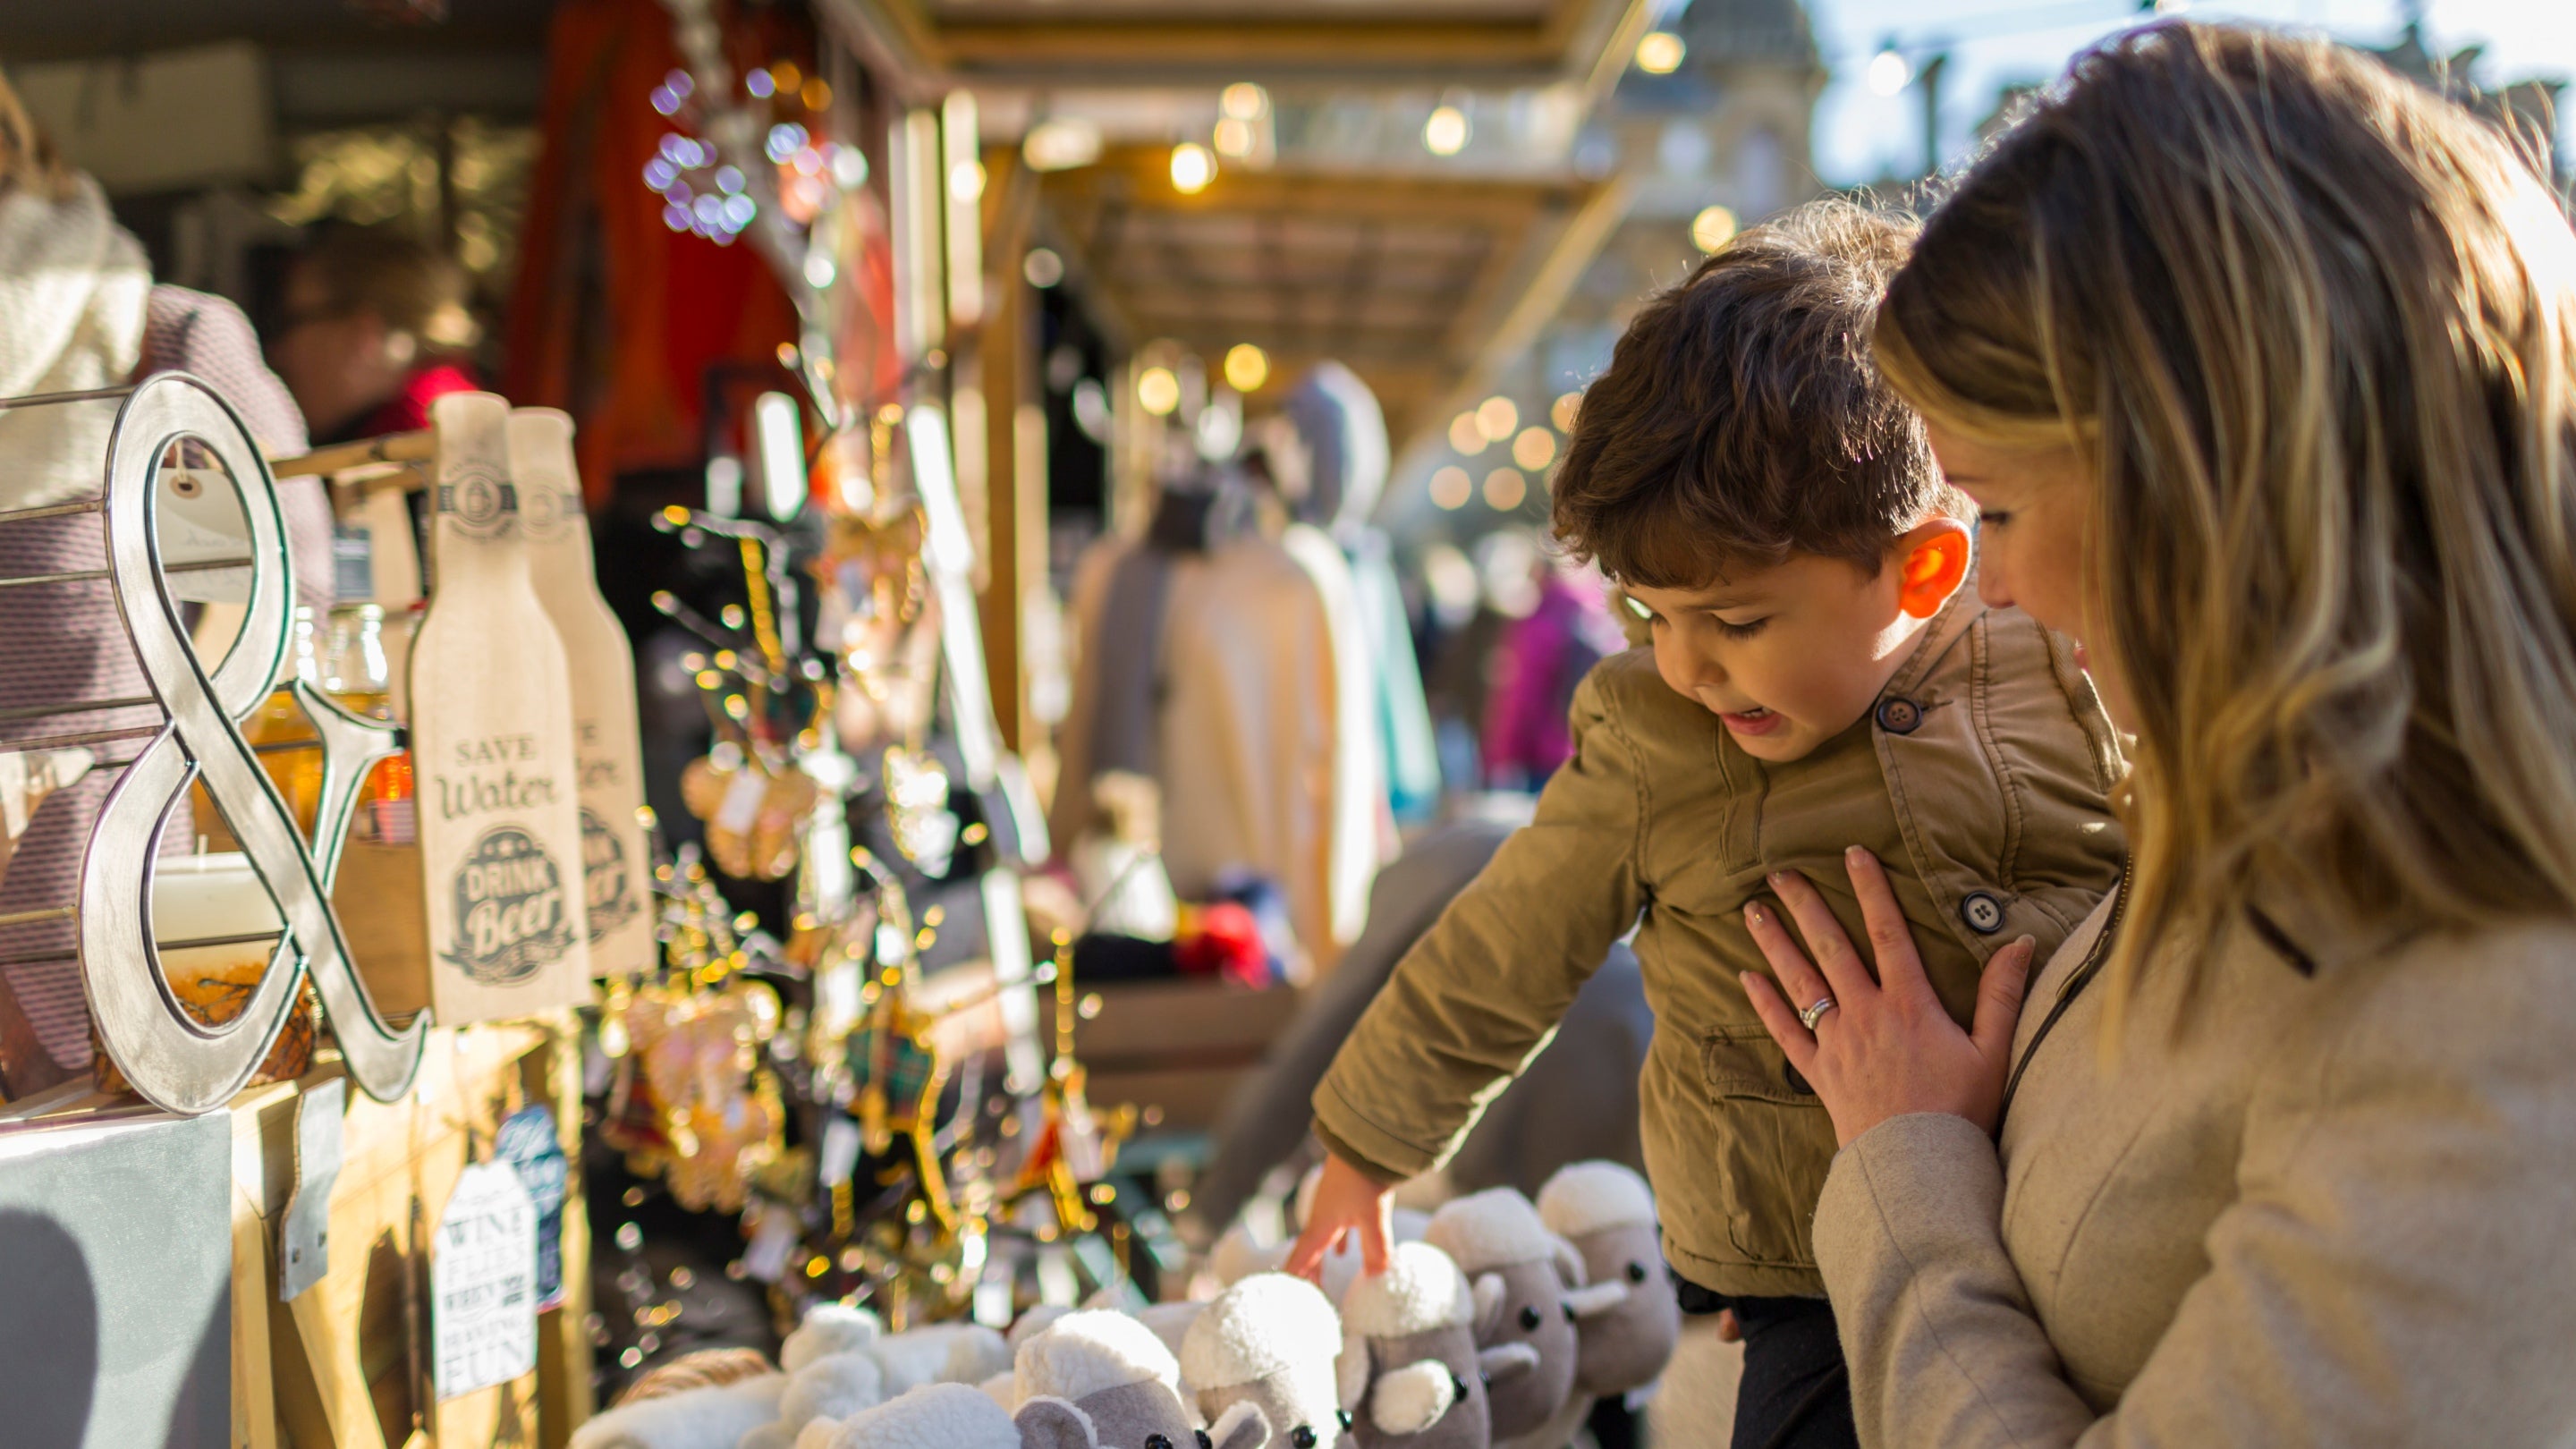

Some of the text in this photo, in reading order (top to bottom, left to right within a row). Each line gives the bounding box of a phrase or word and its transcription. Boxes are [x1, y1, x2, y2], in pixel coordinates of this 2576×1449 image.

[456, 734, 535, 765] SAVE
[436, 770, 556, 819] Water
[466, 857, 551, 901] DRINK
[466, 886, 560, 957] Beer
[443, 1206, 522, 1248] WINE
